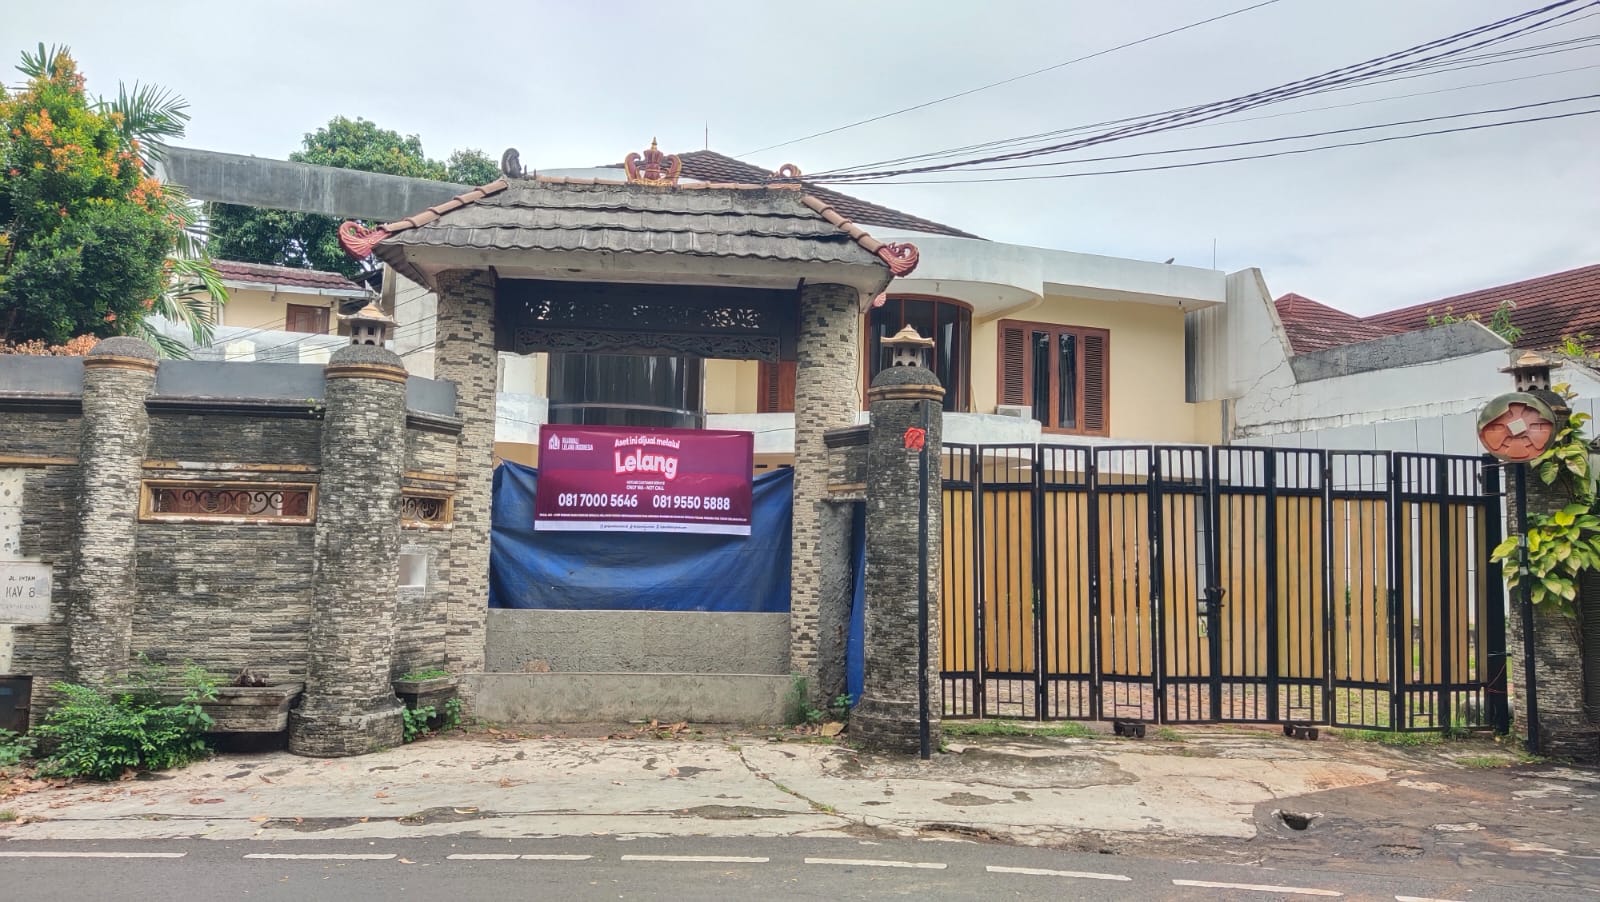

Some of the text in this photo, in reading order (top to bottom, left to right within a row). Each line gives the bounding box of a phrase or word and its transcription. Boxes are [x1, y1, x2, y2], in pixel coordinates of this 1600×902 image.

[615, 438, 629, 447] Aset
[638, 436, 656, 446] dijual
[656, 439, 680, 449] melalui
[615, 449, 678, 479] Lelang
[558, 492, 730, 510] 081 7000 5646 081 9550 5888
[6, 585, 23, 598] KAV
